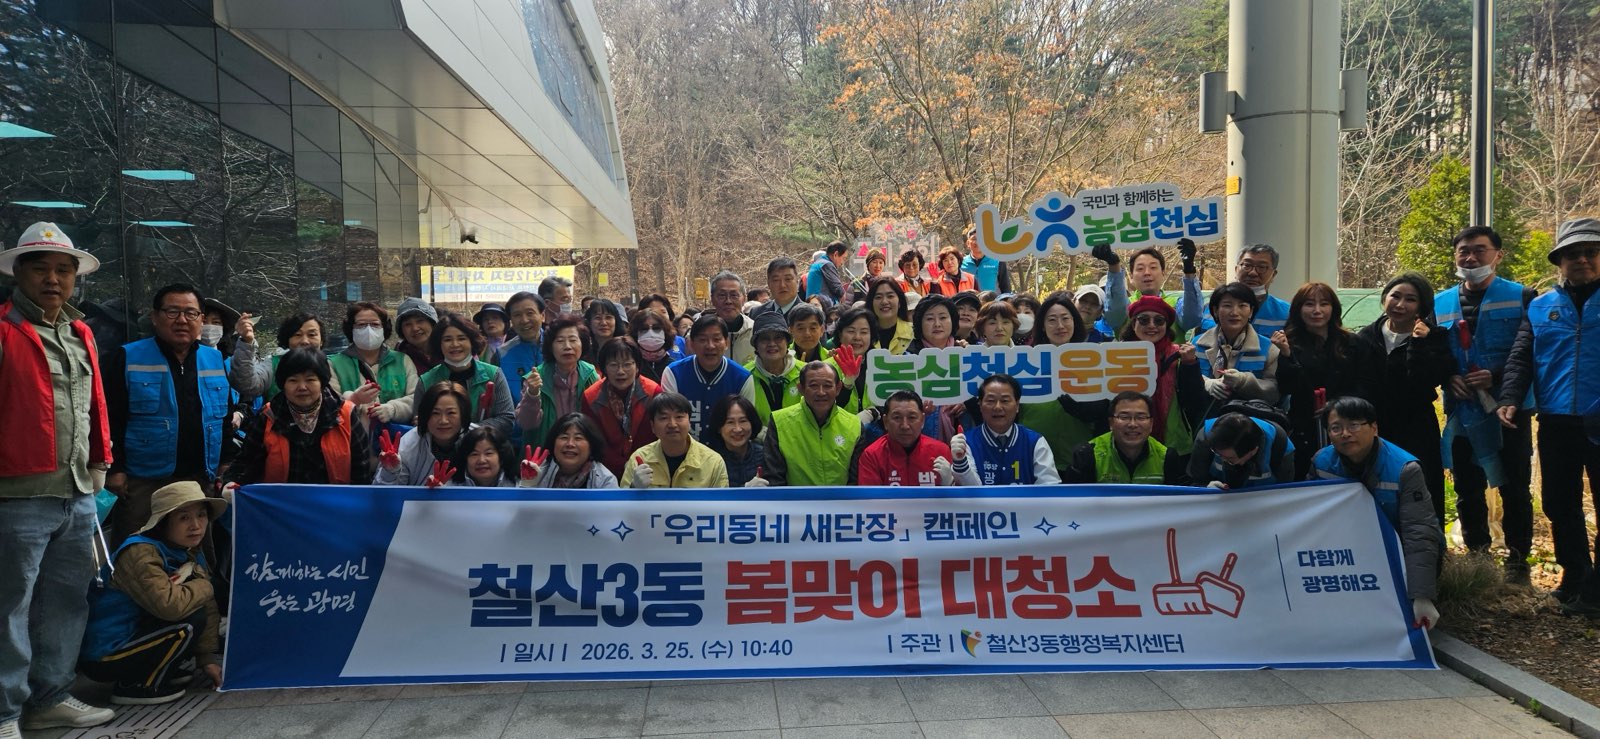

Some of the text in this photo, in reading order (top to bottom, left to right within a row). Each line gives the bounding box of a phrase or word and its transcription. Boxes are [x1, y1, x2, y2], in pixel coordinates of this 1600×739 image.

[1082, 188, 1175, 210] 국민과 함께하는
[1083, 202, 1219, 247] 농심천심
[873, 348, 1151, 400] 농심천심 운동
[1010, 460, 1020, 480] 1
[651, 511, 1021, 545] 「우리동네 새단장」 캠페인
[245, 552, 370, 583] 함께하는 시민
[1297, 548, 1356, 568] 다함께
[468, 555, 1143, 628] 철산3동 봄맞이 대청소
[1301, 573, 1381, 594] 광명해요
[259, 588, 356, 618] 웃는 광명
[514, 639, 793, 663] 일시 2026. 3. 25. (수) 10:40
[901, 633, 1185, 654] 주관 철산3동행정복지센터
